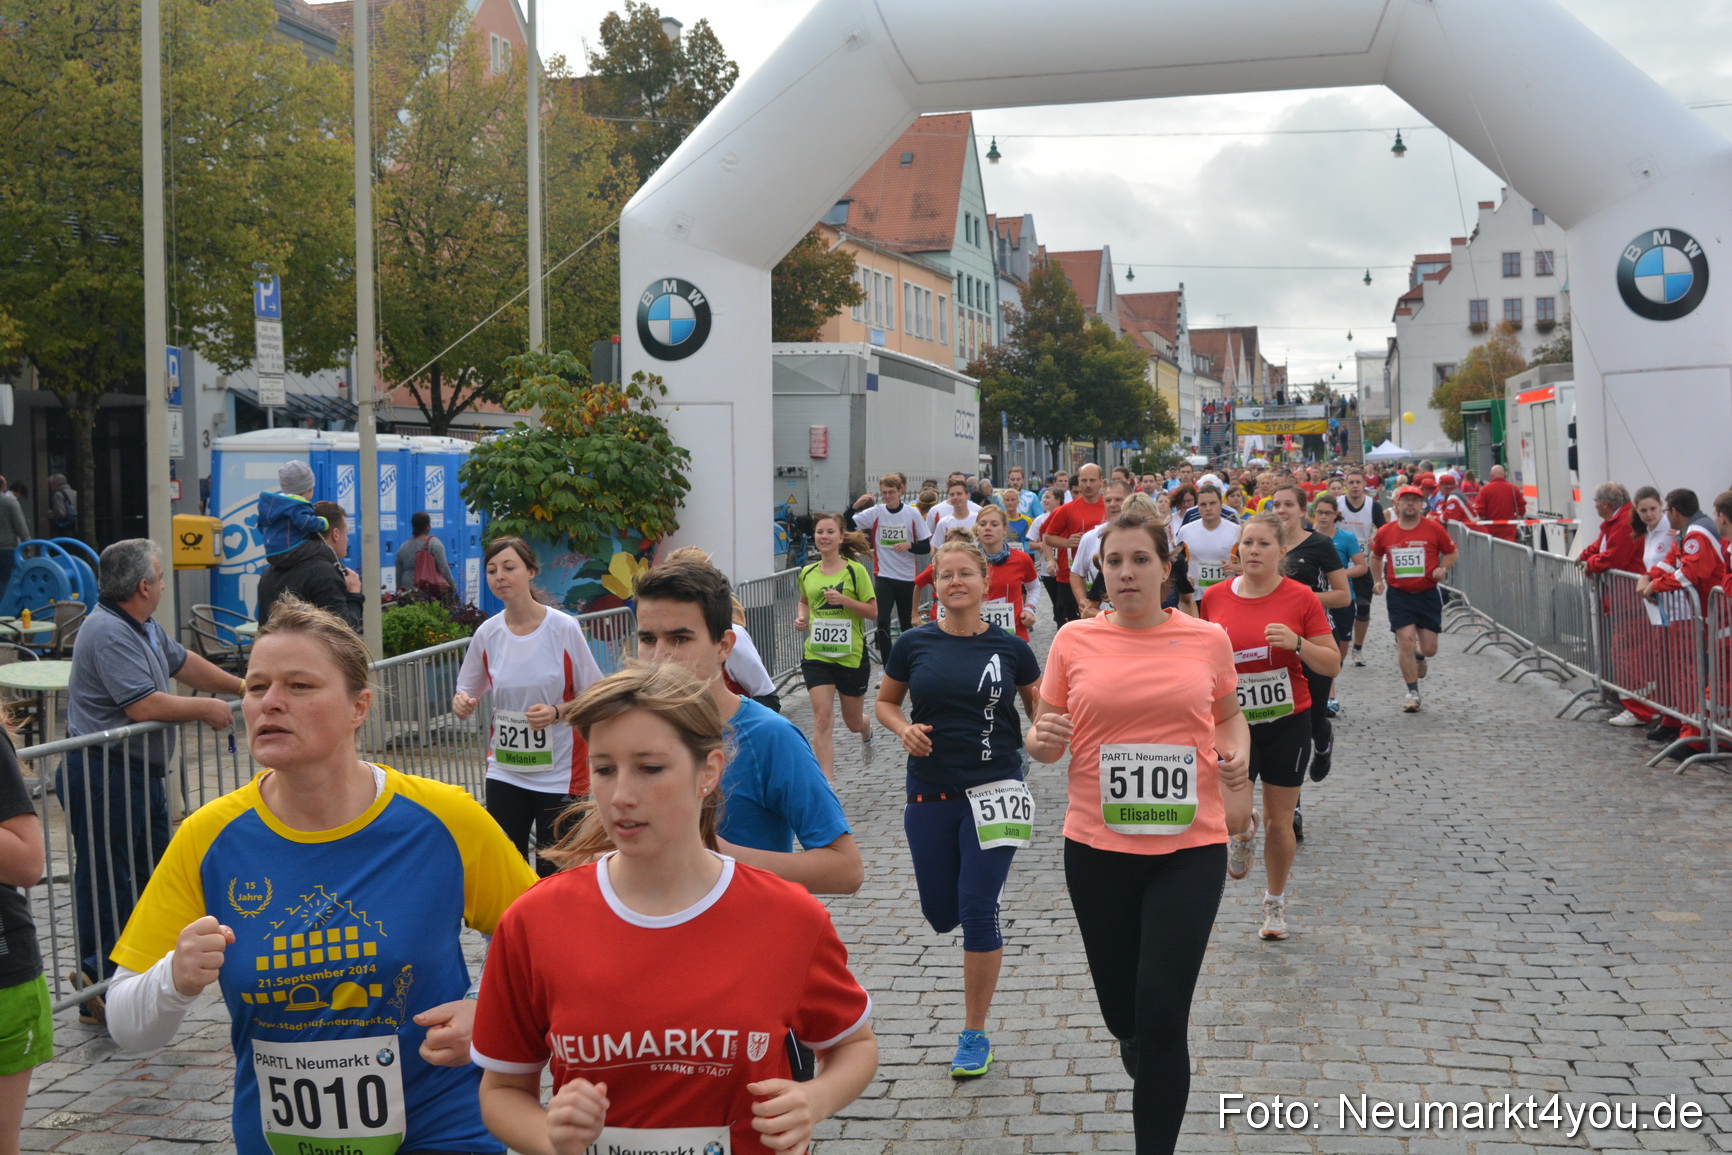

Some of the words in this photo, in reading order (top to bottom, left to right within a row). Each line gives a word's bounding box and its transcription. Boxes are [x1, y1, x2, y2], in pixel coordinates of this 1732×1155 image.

[1624, 230, 1701, 262] BMW
[641, 279, 704, 307] BMW
[955, 409, 975, 440] BOCK
[1265, 424, 1296, 432] START
[203, 430, 210, 448] 3
[882, 529, 904, 539] 5221
[1395, 554, 1421, 566] 5551
[814, 627, 848, 643] 5023
[1248, 675, 1279, 684] Neumarkt
[1236, 683, 1287, 707] 5106
[1248, 709, 1276, 720] Nicole
[499, 724, 547, 749] 5219
[505, 752, 538, 764] Melanie
[1101, 752, 1134, 762] PARTL
[1135, 752, 1181, 763] Neumarkt
[1110, 765, 1188, 800] 5109
[979, 795, 1031, 821] 5126
[1120, 807, 1178, 822] Elisabeth
[1004, 825, 1020, 837] Jana
[245, 882, 256, 890] 15
[237, 893, 263, 902] Jahre
[258, 968, 345, 991] 21.September
[348, 964, 377, 979] 2014
[550, 1028, 738, 1063] NEUMARKT
[255, 1053, 293, 1070] PARTL
[296, 1055, 370, 1070] Neumarkt
[650, 1063, 694, 1075] STARKE
[697, 1065, 732, 1077] STADT
[268, 1074, 388, 1130] 5010
